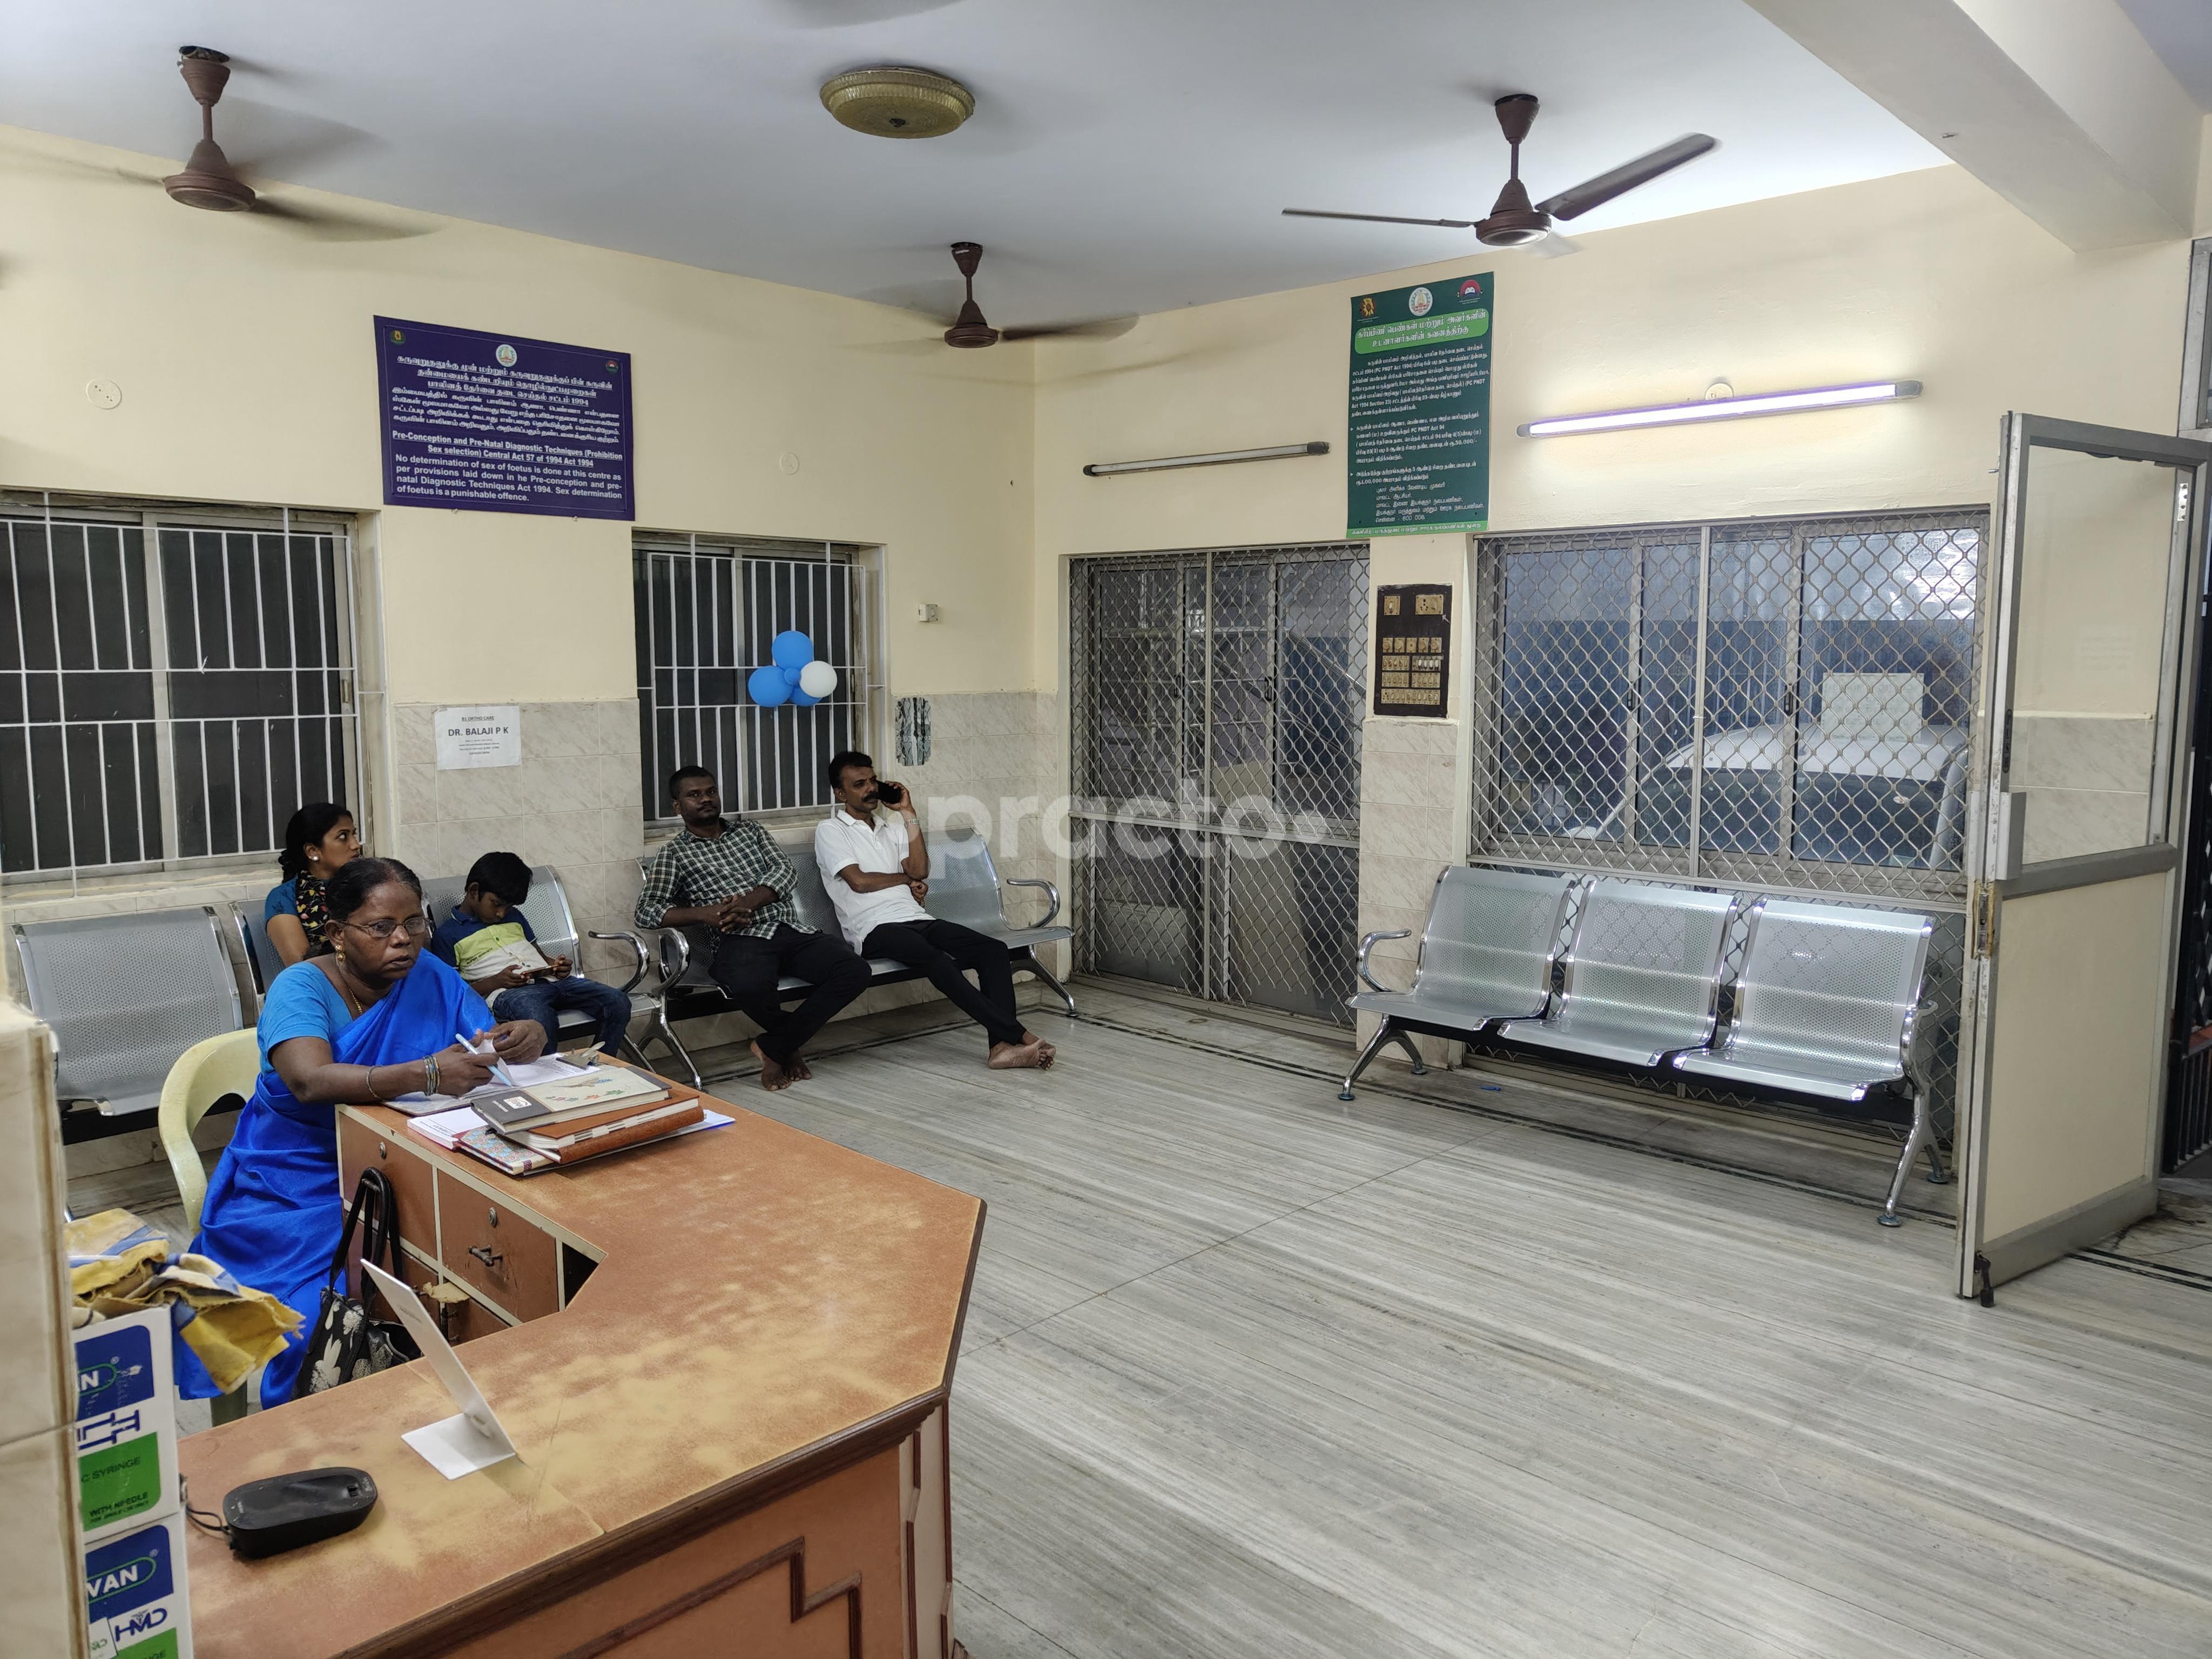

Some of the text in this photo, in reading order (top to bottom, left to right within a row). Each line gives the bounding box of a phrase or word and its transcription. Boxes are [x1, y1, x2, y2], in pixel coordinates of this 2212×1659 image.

[392, 430, 451, 443] Pre-Conception
[469, 437, 503, 448] Pre-Natal
[504, 441, 543, 453] Diagnostic
[544, 444, 583, 456] Techniques
[584, 449, 623, 461] (Prohibition
[427, 444, 442, 453] Sex
[444, 447, 481, 457] selection)
[483, 449, 510, 460] Central
[511, 453, 524, 461] Act
[526, 454, 535, 462] 57
[545, 455, 562, 464] 1994
[563, 457, 576, 466] Act
[577, 458, 594, 467] 1994
[395, 453, 408, 462] No
[409, 455, 469, 467] determination
[507, 463, 532, 473] foetus
[542, 467, 562, 475] done
[572, 469, 586, 477] this
[414, 464, 460, 476] provisions
[462, 469, 477, 477] laid
[481, 471, 503, 480] down
[506, 473, 514, 481] in
[517, 474, 527, 482] he
[530, 475, 588, 487] Pre-conception
[396, 484, 406, 493] of
[407, 485, 434, 495] foetus
[435, 487, 443, 495] is
[450, 489, 496, 498] punishable
[497, 492, 529, 501] offence.
[420, 476, 466, 487] Diagnostic
[468, 480, 515, 490] Techniques
[517, 483, 531, 492] Act
[533, 484, 553, 493] 1994.
[555, 486, 570, 495] Sex
[571, 488, 622, 498] determination
[466, 727, 493, 735] BALAJI
[92, 1456, 140, 1480] SYRINGE
[90, 1505, 111, 1516] WITH
[114, 1492, 148, 1509] NEEDLE
[114, 1607, 168, 1642] HMD
